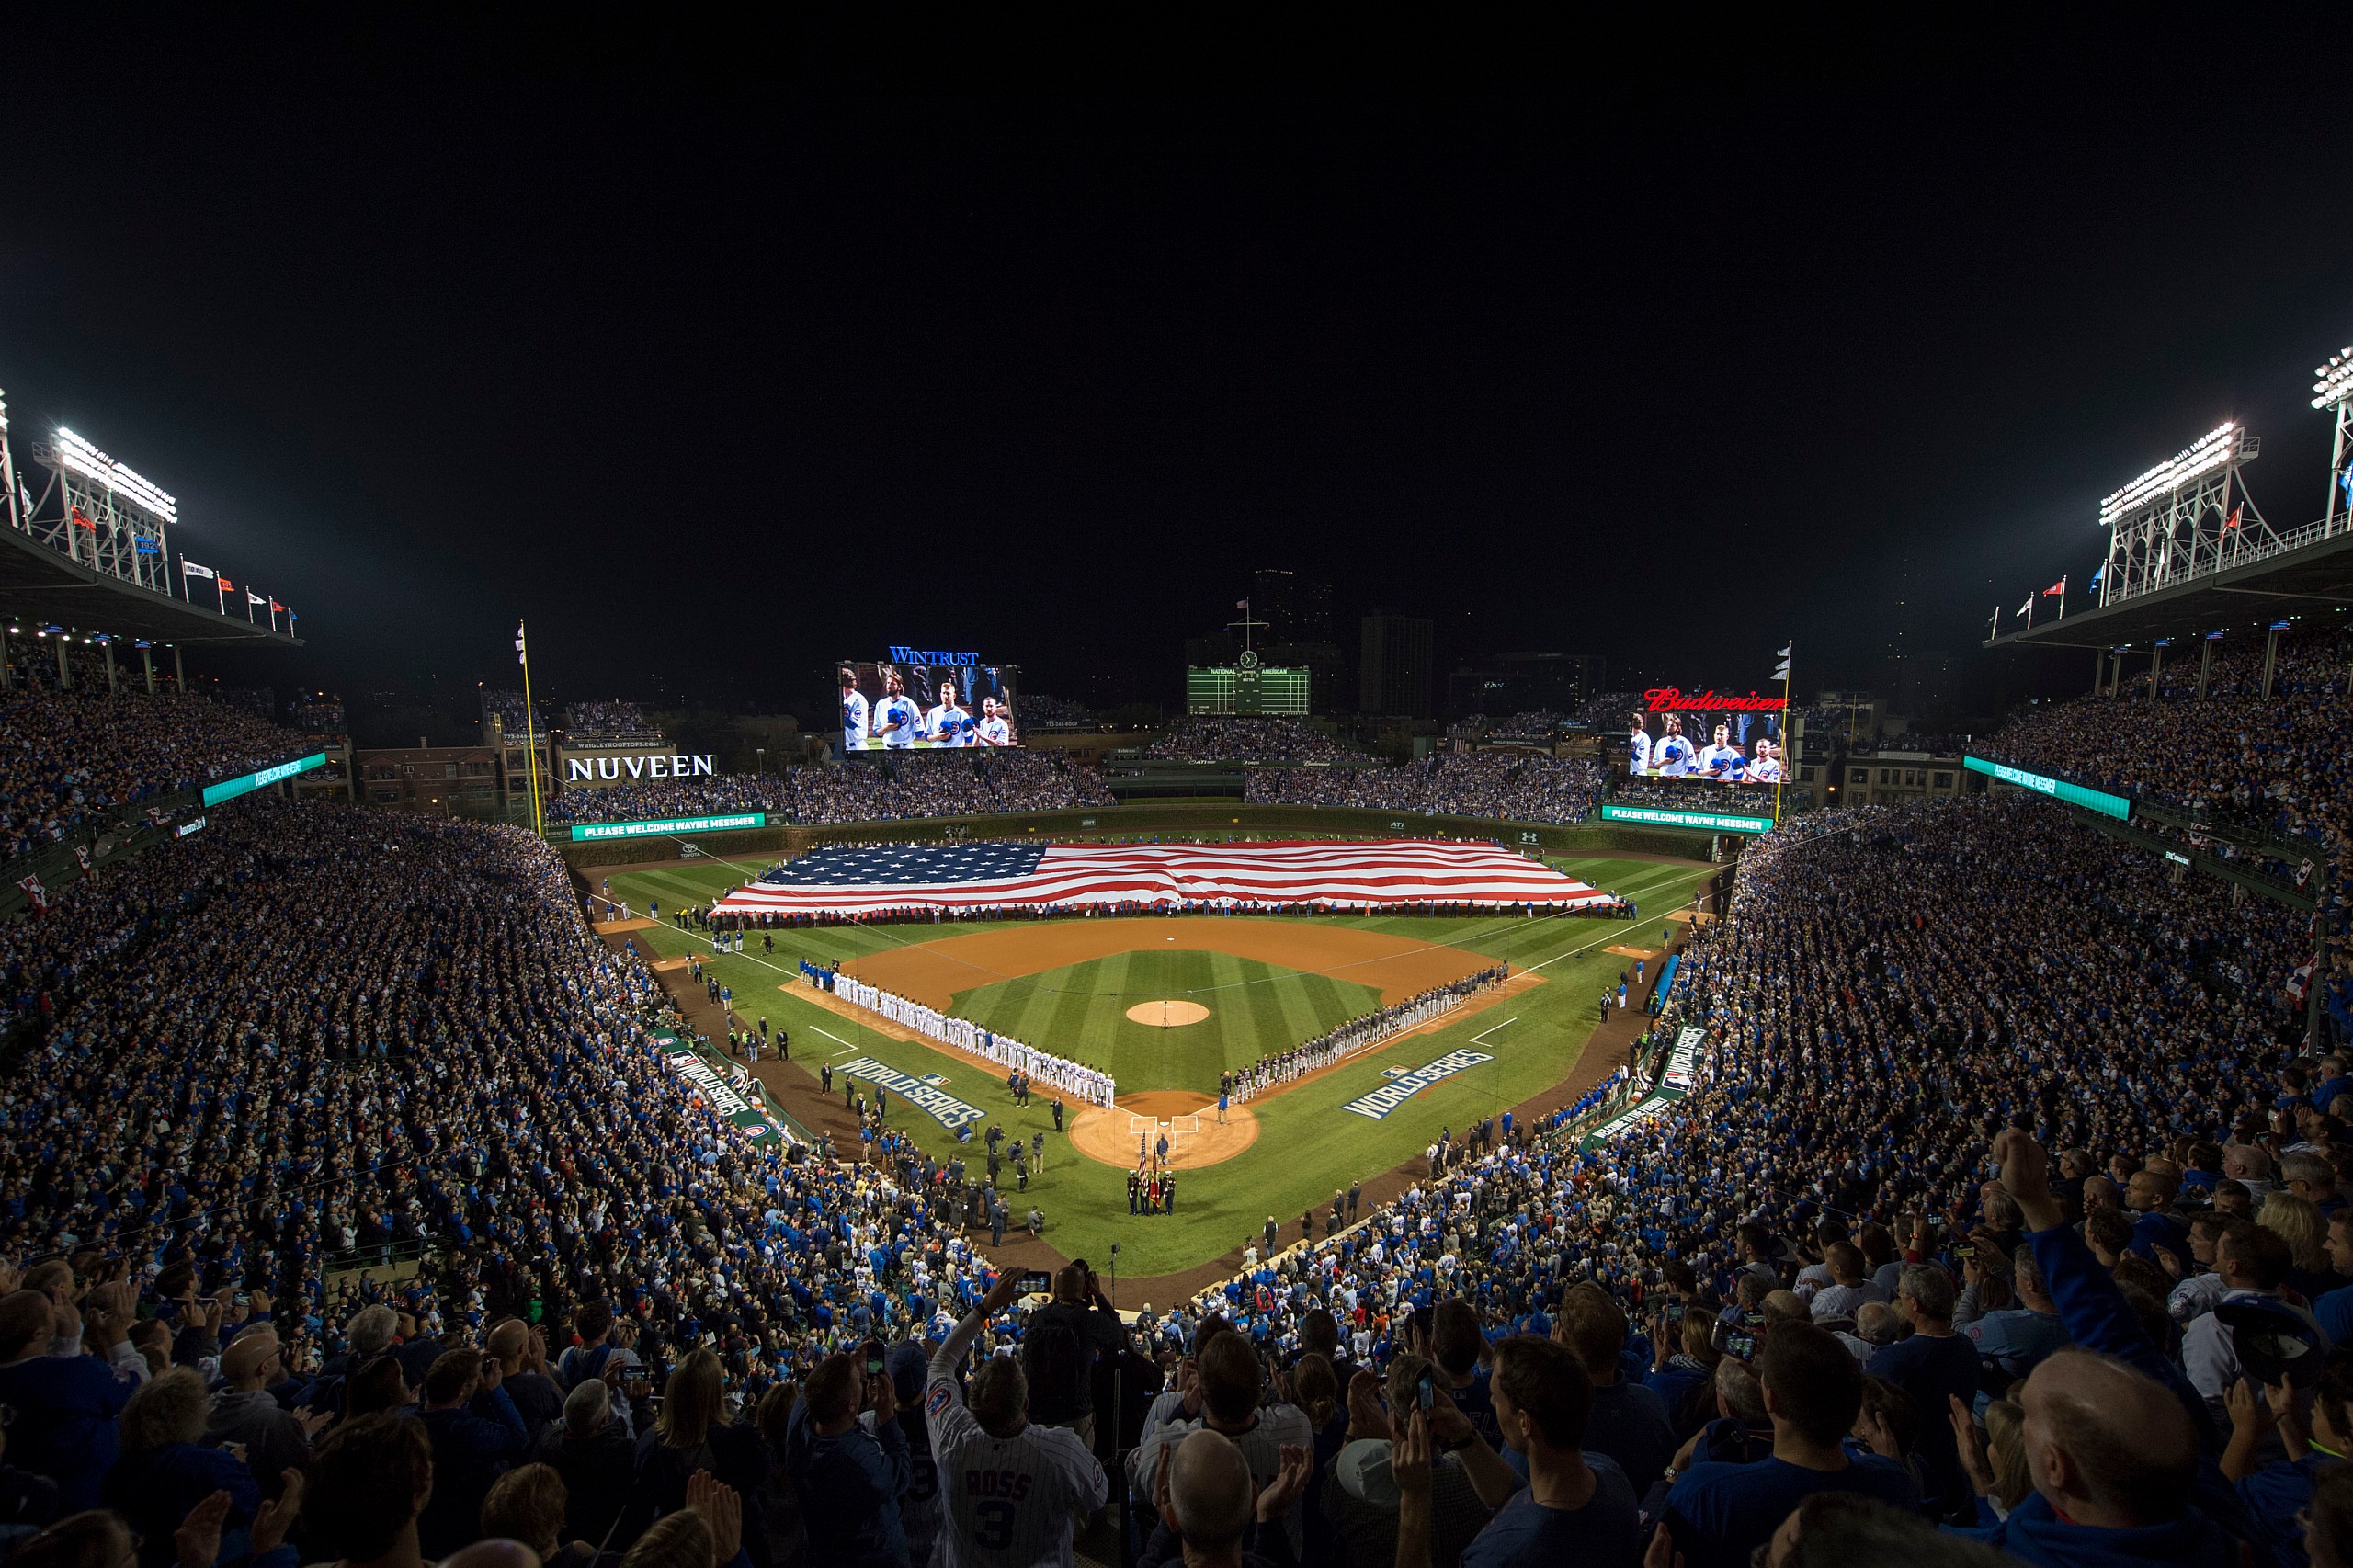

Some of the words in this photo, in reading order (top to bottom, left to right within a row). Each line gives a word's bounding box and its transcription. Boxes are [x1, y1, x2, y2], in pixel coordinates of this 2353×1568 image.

[889, 646, 979, 665] WINTRUST
[1643, 688, 1790, 711] Budweiser
[569, 755, 713, 781] NUVEEN
[585, 825, 625, 837] PLEASE
[627, 823, 675, 834] WELCOME
[676, 819, 709, 830] WAYNE
[710, 817, 756, 828] MESSMER
[1611, 809, 1643, 820] PLEASE
[1643, 812, 1684, 824] WELCOME
[1685, 814, 1716, 825] WAYNE
[1717, 817, 1763, 830] MESSMER
[677, 1062, 724, 1090] WORLD
[707, 1085, 750, 1117] SERIES
[833, 1056, 920, 1092] WORLD
[904, 1085, 986, 1129] SERIES
[1343, 1076, 1429, 1119] WORLD
[1417, 1048, 1495, 1082] SERIES
[966, 1470, 1032, 1502] ROSS
[975, 1500, 1015, 1551] 3
